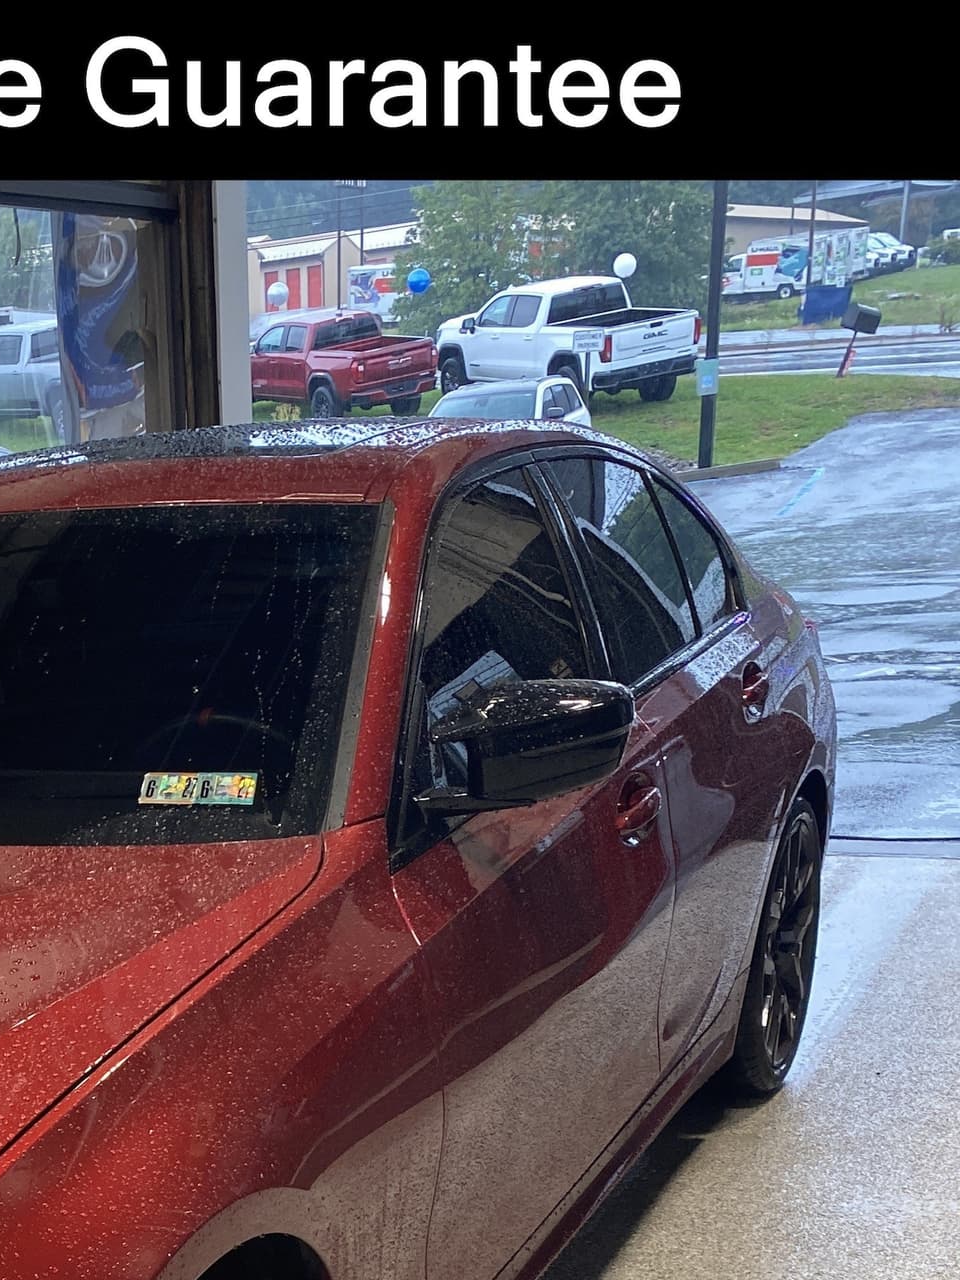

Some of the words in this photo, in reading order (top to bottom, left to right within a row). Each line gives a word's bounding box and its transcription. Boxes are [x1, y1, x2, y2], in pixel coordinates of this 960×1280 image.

[642, 329, 669, 340] GMC
[146, 779, 157, 798] 6
[200, 779, 212, 798] 6
